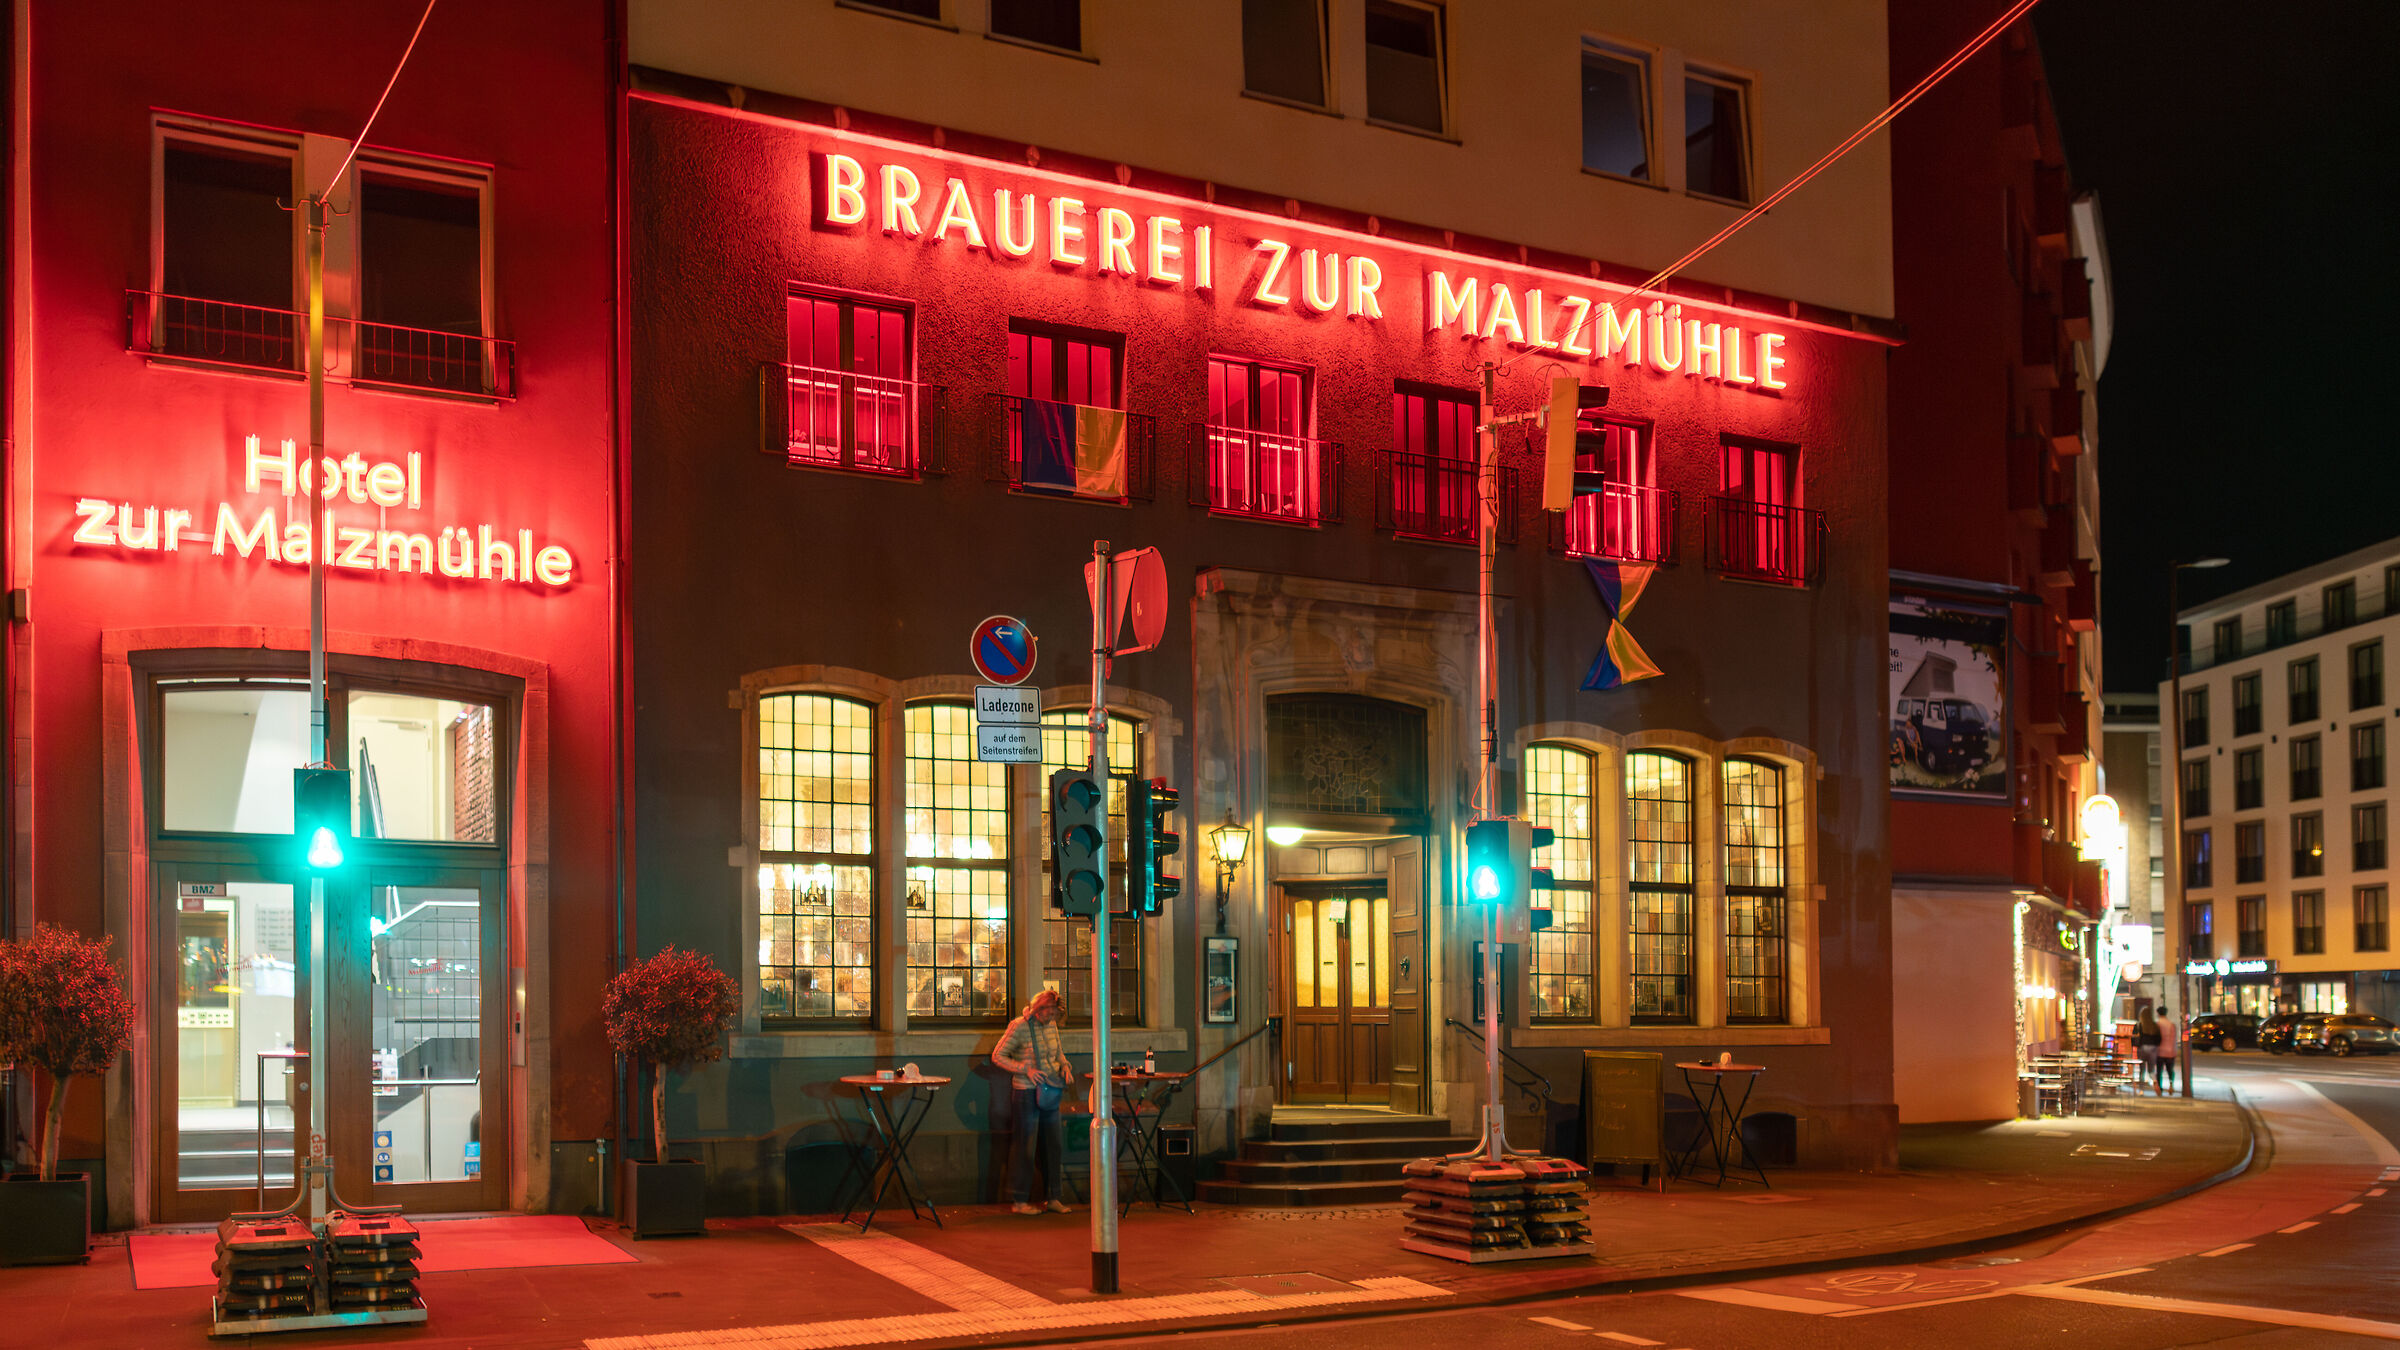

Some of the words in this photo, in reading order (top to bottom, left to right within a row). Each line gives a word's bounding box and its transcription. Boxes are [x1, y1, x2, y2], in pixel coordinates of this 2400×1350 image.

[826, 154, 1212, 290] BRAUEREI
[1252, 238, 1383, 321] ZUR
[1428, 270, 1787, 391] MALZMÜHLE
[245, 433, 422, 510] Hotel
[74, 498, 191, 551] zur
[212, 502, 572, 586] Malzmühle
[982, 698, 1034, 713] Ladezone
[993, 734, 1008, 743] auf
[1008, 734, 1026, 743] dem
[982, 746, 1038, 755] Seitenstreifen
[192, 885, 215, 894] BMZ
